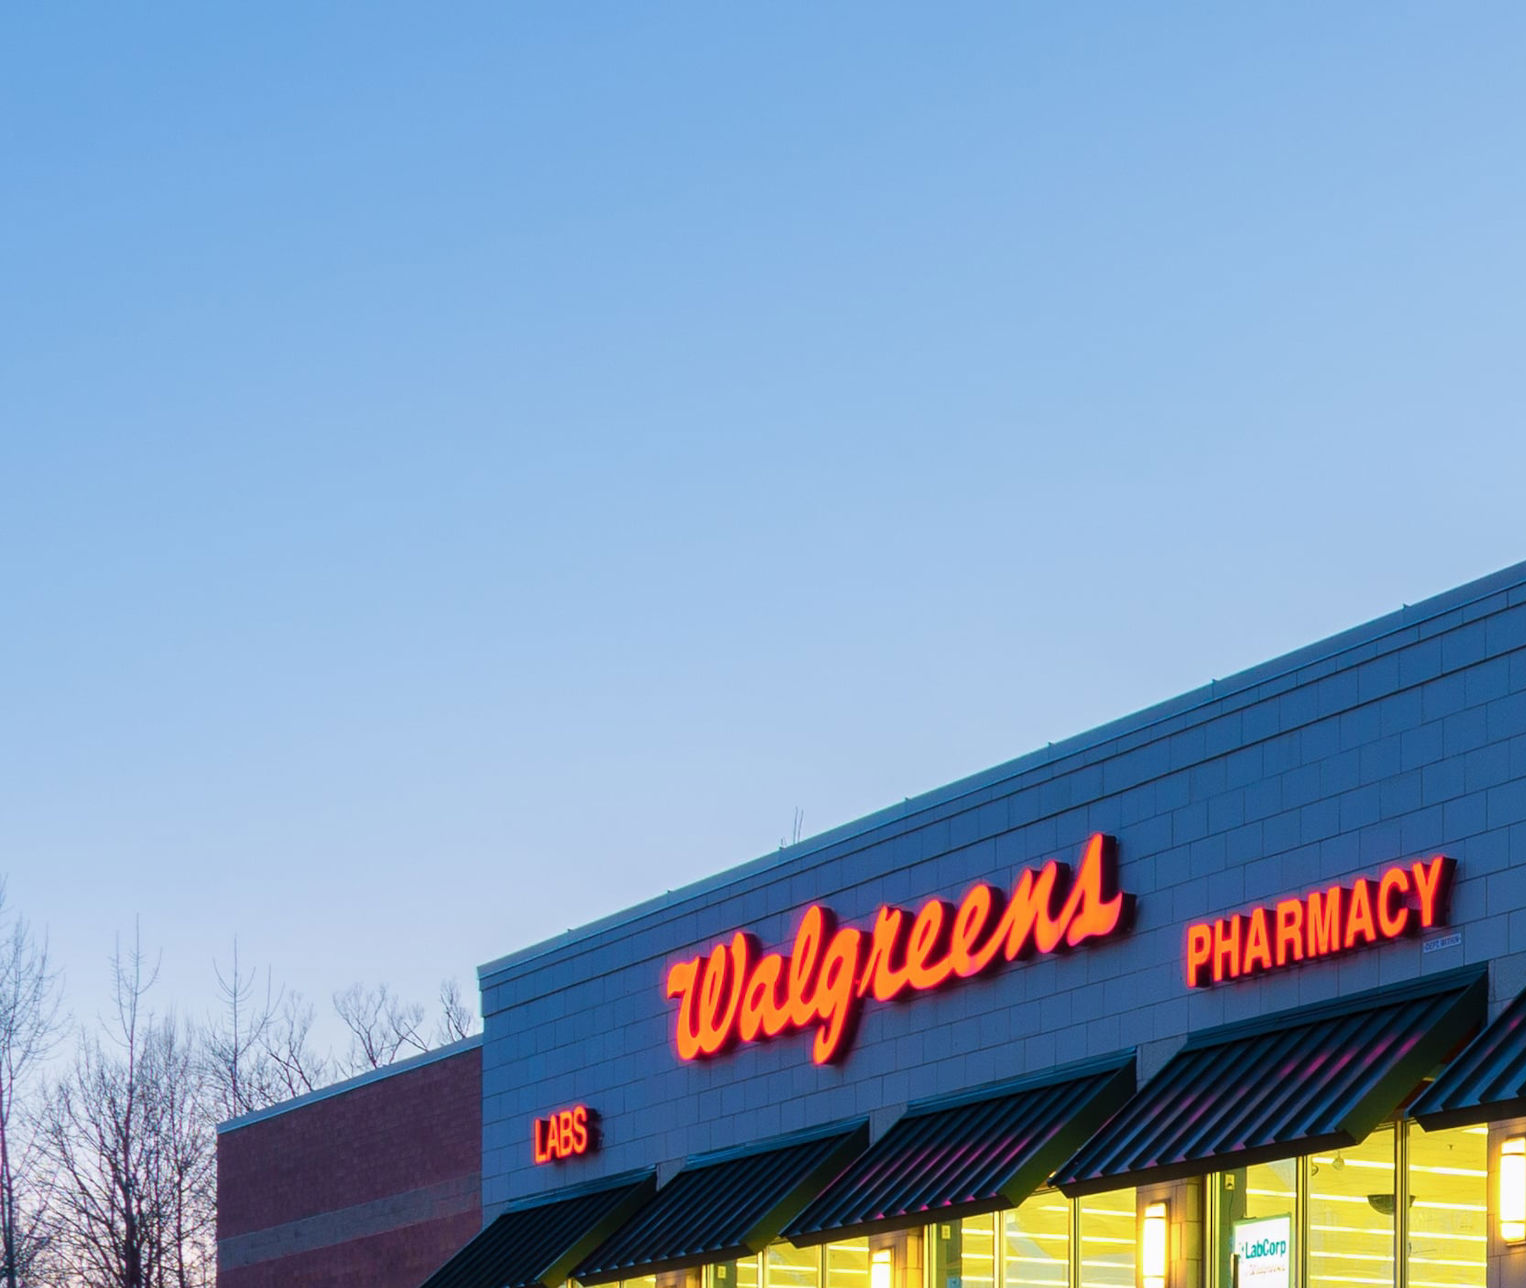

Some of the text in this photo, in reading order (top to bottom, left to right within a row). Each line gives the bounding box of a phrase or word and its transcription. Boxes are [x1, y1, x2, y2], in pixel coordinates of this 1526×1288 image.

[666, 830, 1122, 1065] Walgreens
[1186, 854, 1447, 988] PHARMACY
[534, 1104, 588, 1164] LABS
[1245, 1237, 1287, 1260] LabCorp
